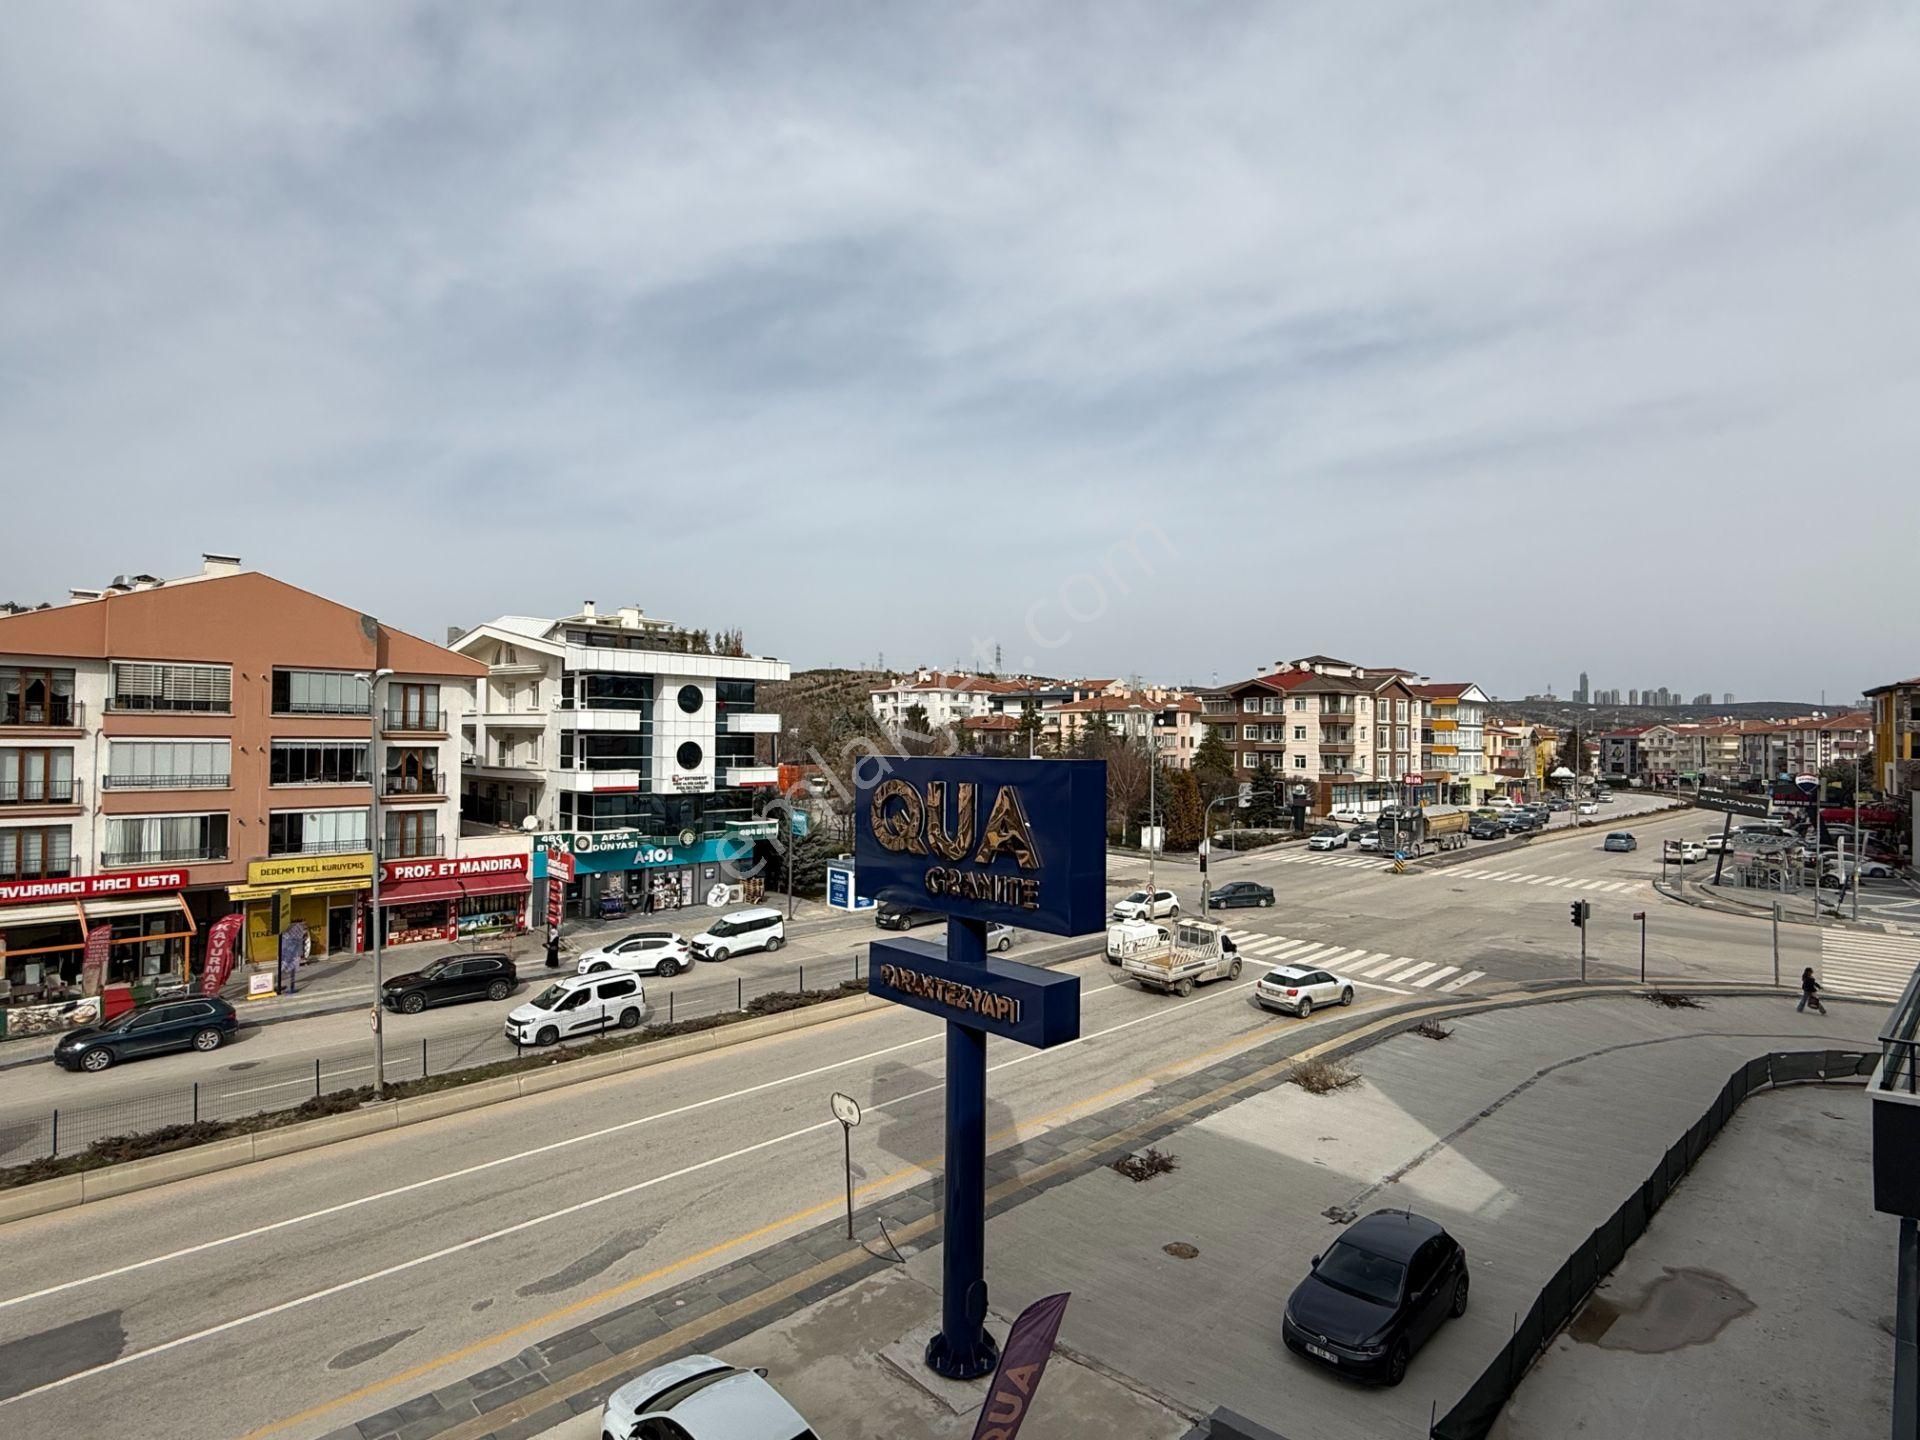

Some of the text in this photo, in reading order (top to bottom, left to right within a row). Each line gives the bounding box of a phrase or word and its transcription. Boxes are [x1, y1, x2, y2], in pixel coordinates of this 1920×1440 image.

[869, 778, 1041, 869] QUA
[592, 841, 639, 852] DÜNYASI
[601, 833, 630, 842] ARSA
[297, 865, 320, 874] TEKEL
[394, 857, 522, 880] PROF. ET MANDIRA
[92, 877, 131, 891] HACI
[137, 873, 181, 888] USTA
[924, 866, 1040, 910] GRANITE
[204, 923, 231, 995] KAVURMAC
